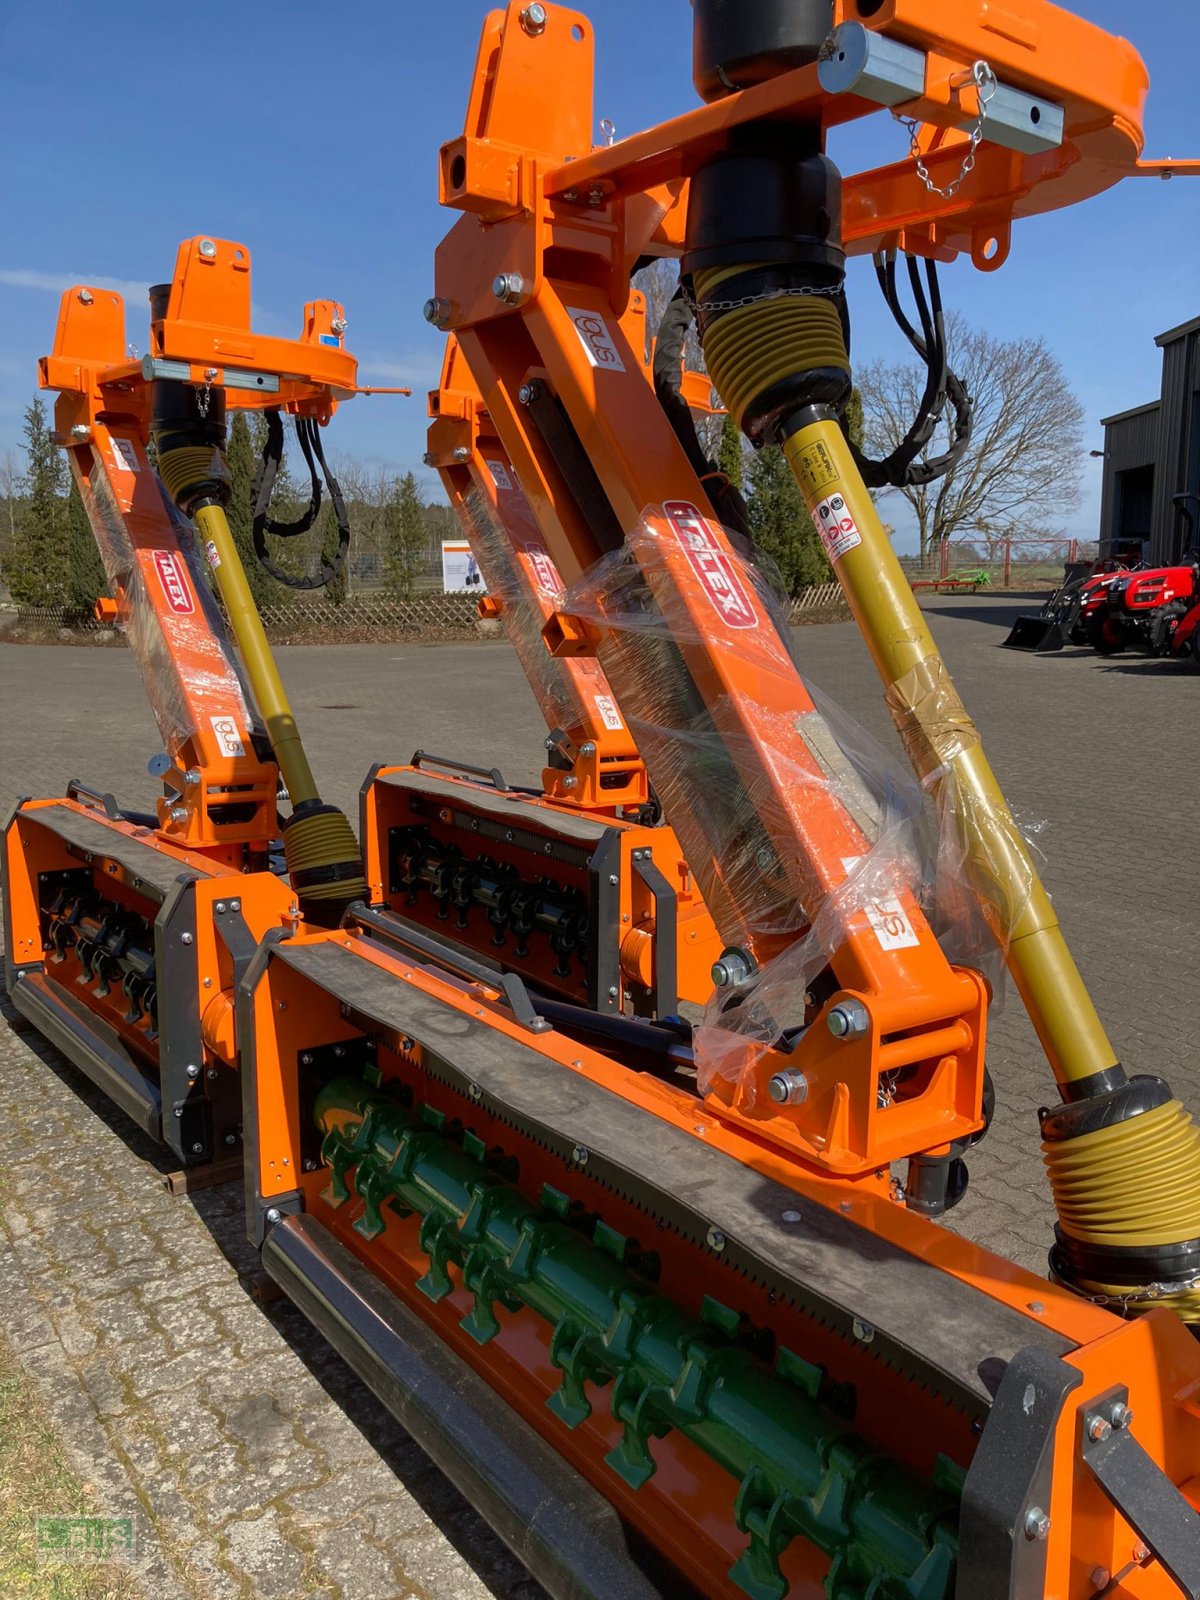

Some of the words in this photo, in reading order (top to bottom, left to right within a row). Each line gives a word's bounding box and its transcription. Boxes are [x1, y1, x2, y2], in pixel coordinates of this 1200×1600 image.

[574, 315, 616, 363] igus
[159, 554, 190, 609] TALEX
[676, 508, 750, 618] TALEX
[214, 720, 240, 752] igus
